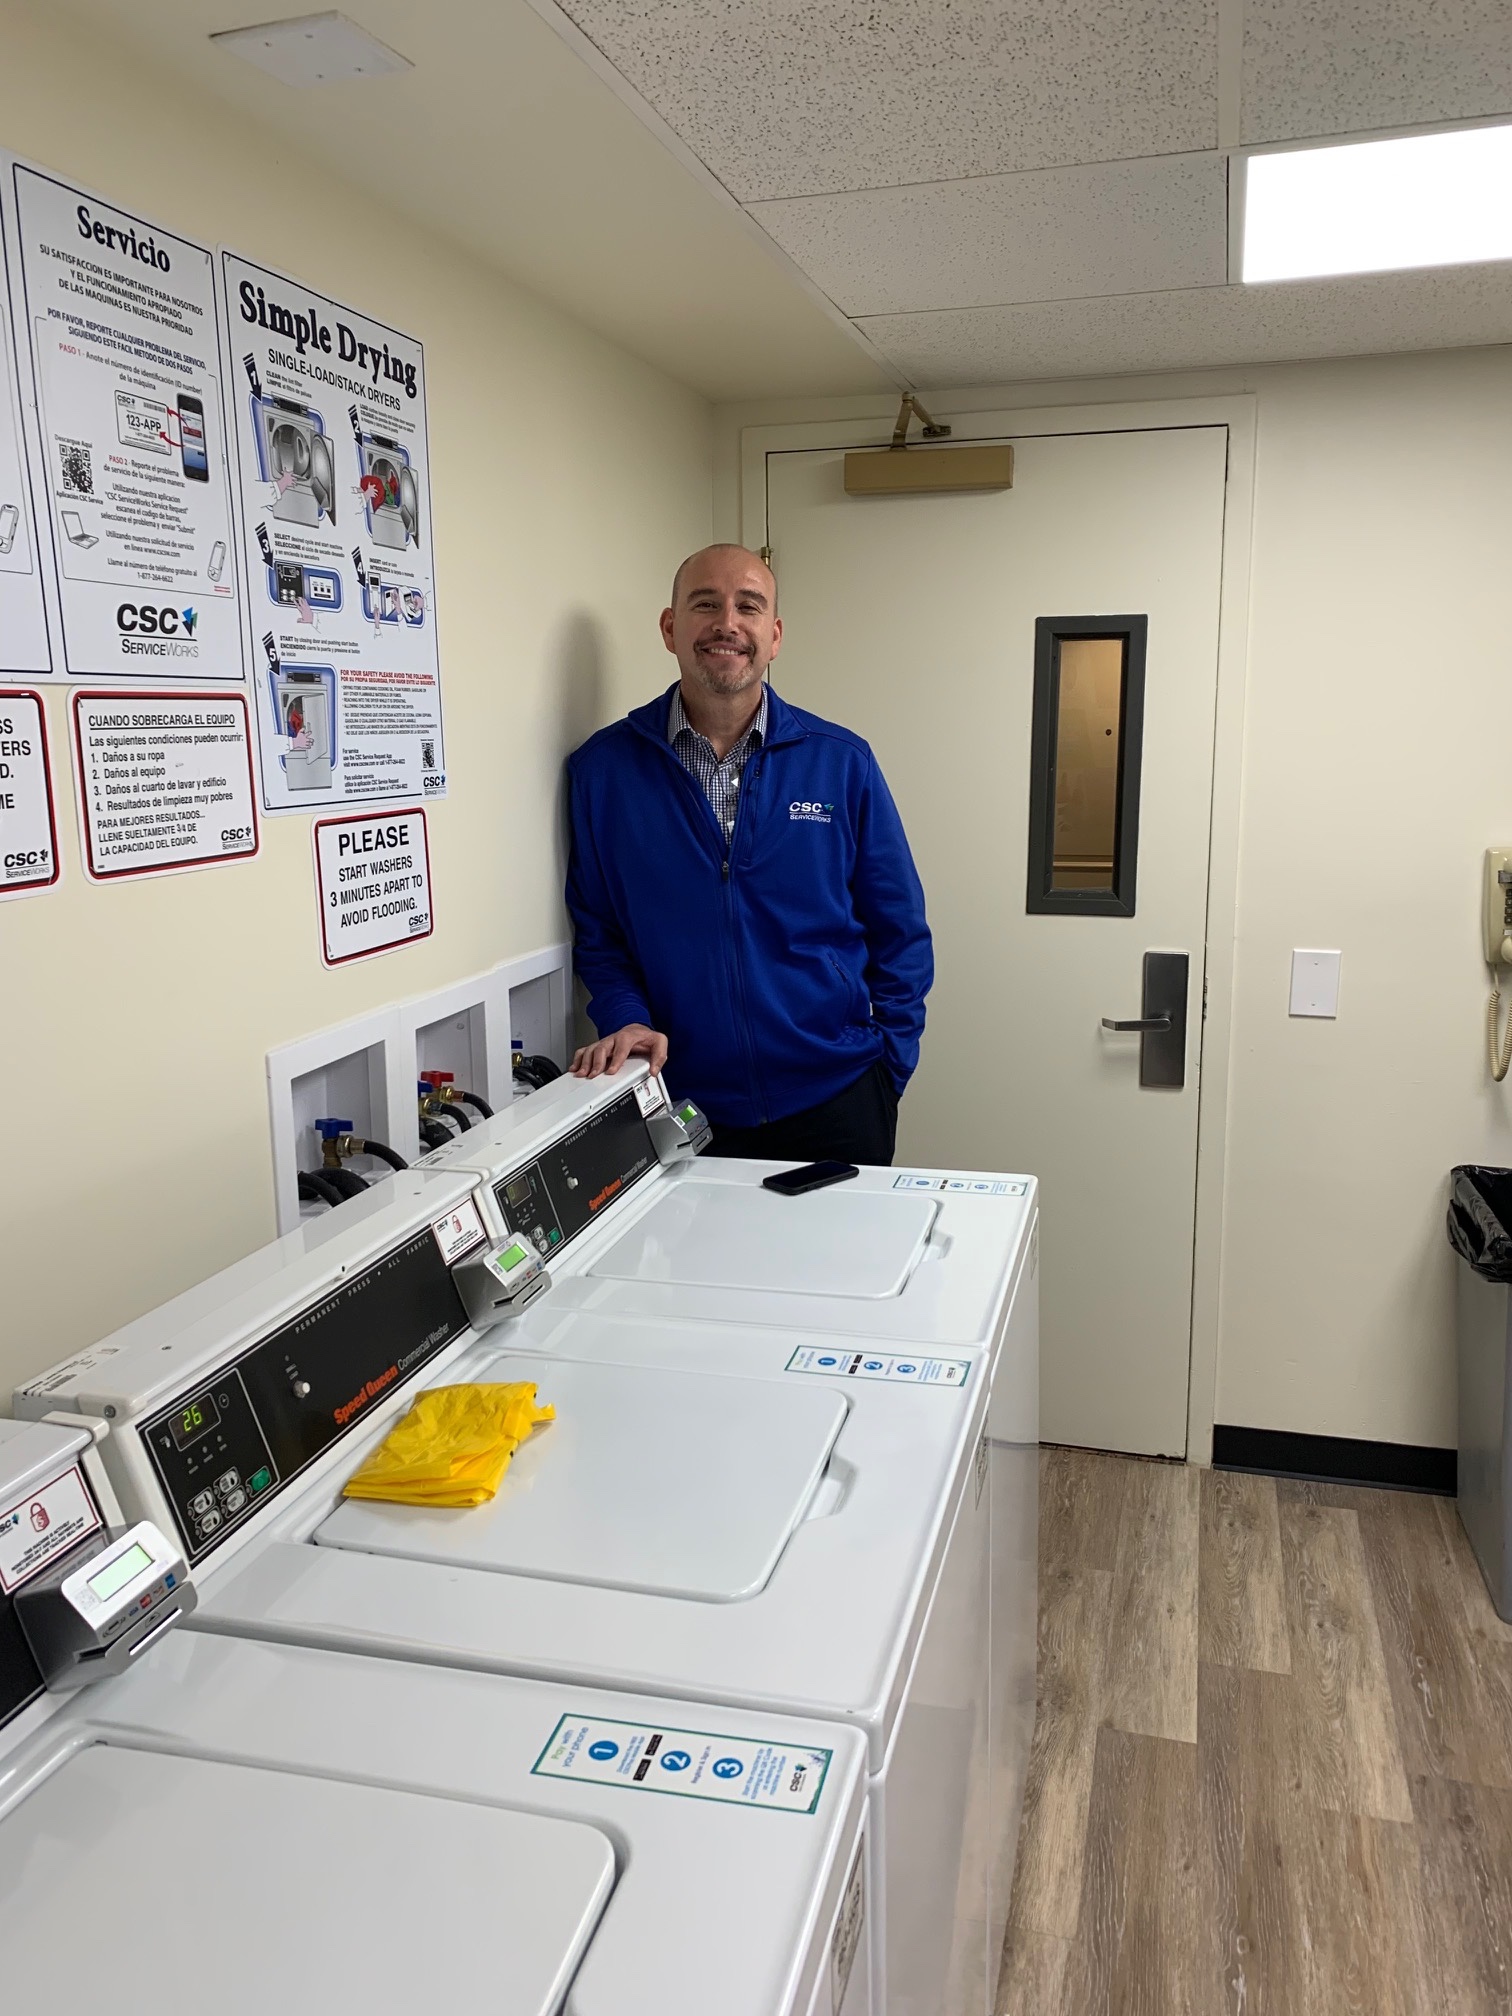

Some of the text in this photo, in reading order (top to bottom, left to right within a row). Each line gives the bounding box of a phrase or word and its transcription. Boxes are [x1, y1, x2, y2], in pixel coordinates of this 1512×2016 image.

[76, 205, 170, 272] Servicio
[40, 244, 203, 316] SU SATISFACCION ES IMPORTANTE PARA NOSOTROS
[70, 269, 182, 320] Y EL FUNCIONAMIENTO APROPIADO
[59, 278, 193, 336] DE LAS MAQUINAS ES NUESTRA PRIORIDAD
[48, 308, 206, 370] POR FAVOR, REPORTE CUALQUIER PROBLEMA DEL SERVICIO,
[239, 280, 417, 399] Simple Drying
[59, 343, 76, 355] PASO
[68, 326, 193, 375] SIGUIENDO ESTE FACIL METODO DE DOS PASOS
[250, 370, 256, 385] 1
[368, 386, 400, 411] DRYERS
[126, 414, 162, 432] 123-APP
[353, 420, 359, 433] 2
[109, 455, 124, 464] PASO
[262, 539, 269, 553] 3
[358, 562, 363, 574] 4
[117, 603, 178, 634] CSC
[269, 648, 276, 661] 5
[89, 714, 235, 726] CUANDO SOBRECARGA EL EQUIPO
[89, 733, 244, 748] Las siguientes condiciones pueden ocurrir:
[91, 753, 98, 763] 1.
[102, 752, 128, 763] Daños
[136, 753, 146, 761] su
[148, 751, 165, 762] ropa
[92, 766, 166, 780] 2. Daños al equipo
[423, 776, 440, 787] CSC
[94, 777, 226, 796] 3. Daños al cuarto de lavar y edificio
[95, 792, 233, 812] 4. Resultados de limpieza muy pobres
[789, 802, 822, 812] CSC
[98, 819, 118, 829] PARA
[120, 815, 154, 827] MEJORES
[98, 831, 123, 843] LLENE
[125, 826, 174, 839] SUELTAMENTE
[188, 823, 197, 832] DE
[221, 828, 244, 841] CSC
[339, 824, 409, 856] PLEASE
[100, 835, 198, 856] LA CAPACIDAD DEL EQUIPO.
[4, 851, 38, 867] CSC
[339, 855, 412, 882] START WASHERS
[330, 874, 422, 907] 3 MINUTES APART TO
[341, 897, 418, 928] AVOID FLOODING.
[408, 914, 424, 926] CSC
[295, 1298, 340, 1334] PERMANENT
[348, 1278, 371, 1296] PRESS
[388, 1258, 400, 1269] ALL
[406, 1237, 429, 1255] FABRIC
[334, 1323, 450, 1424] Speed Queen Commercial Washer
[182, 1405, 203, 1432] 26
[571, 1727, 589, 1751] phone
[664, 1754, 687, 1767] 2
[716, 1762, 740, 1775] 3
[789, 1772, 802, 1792] CSC
